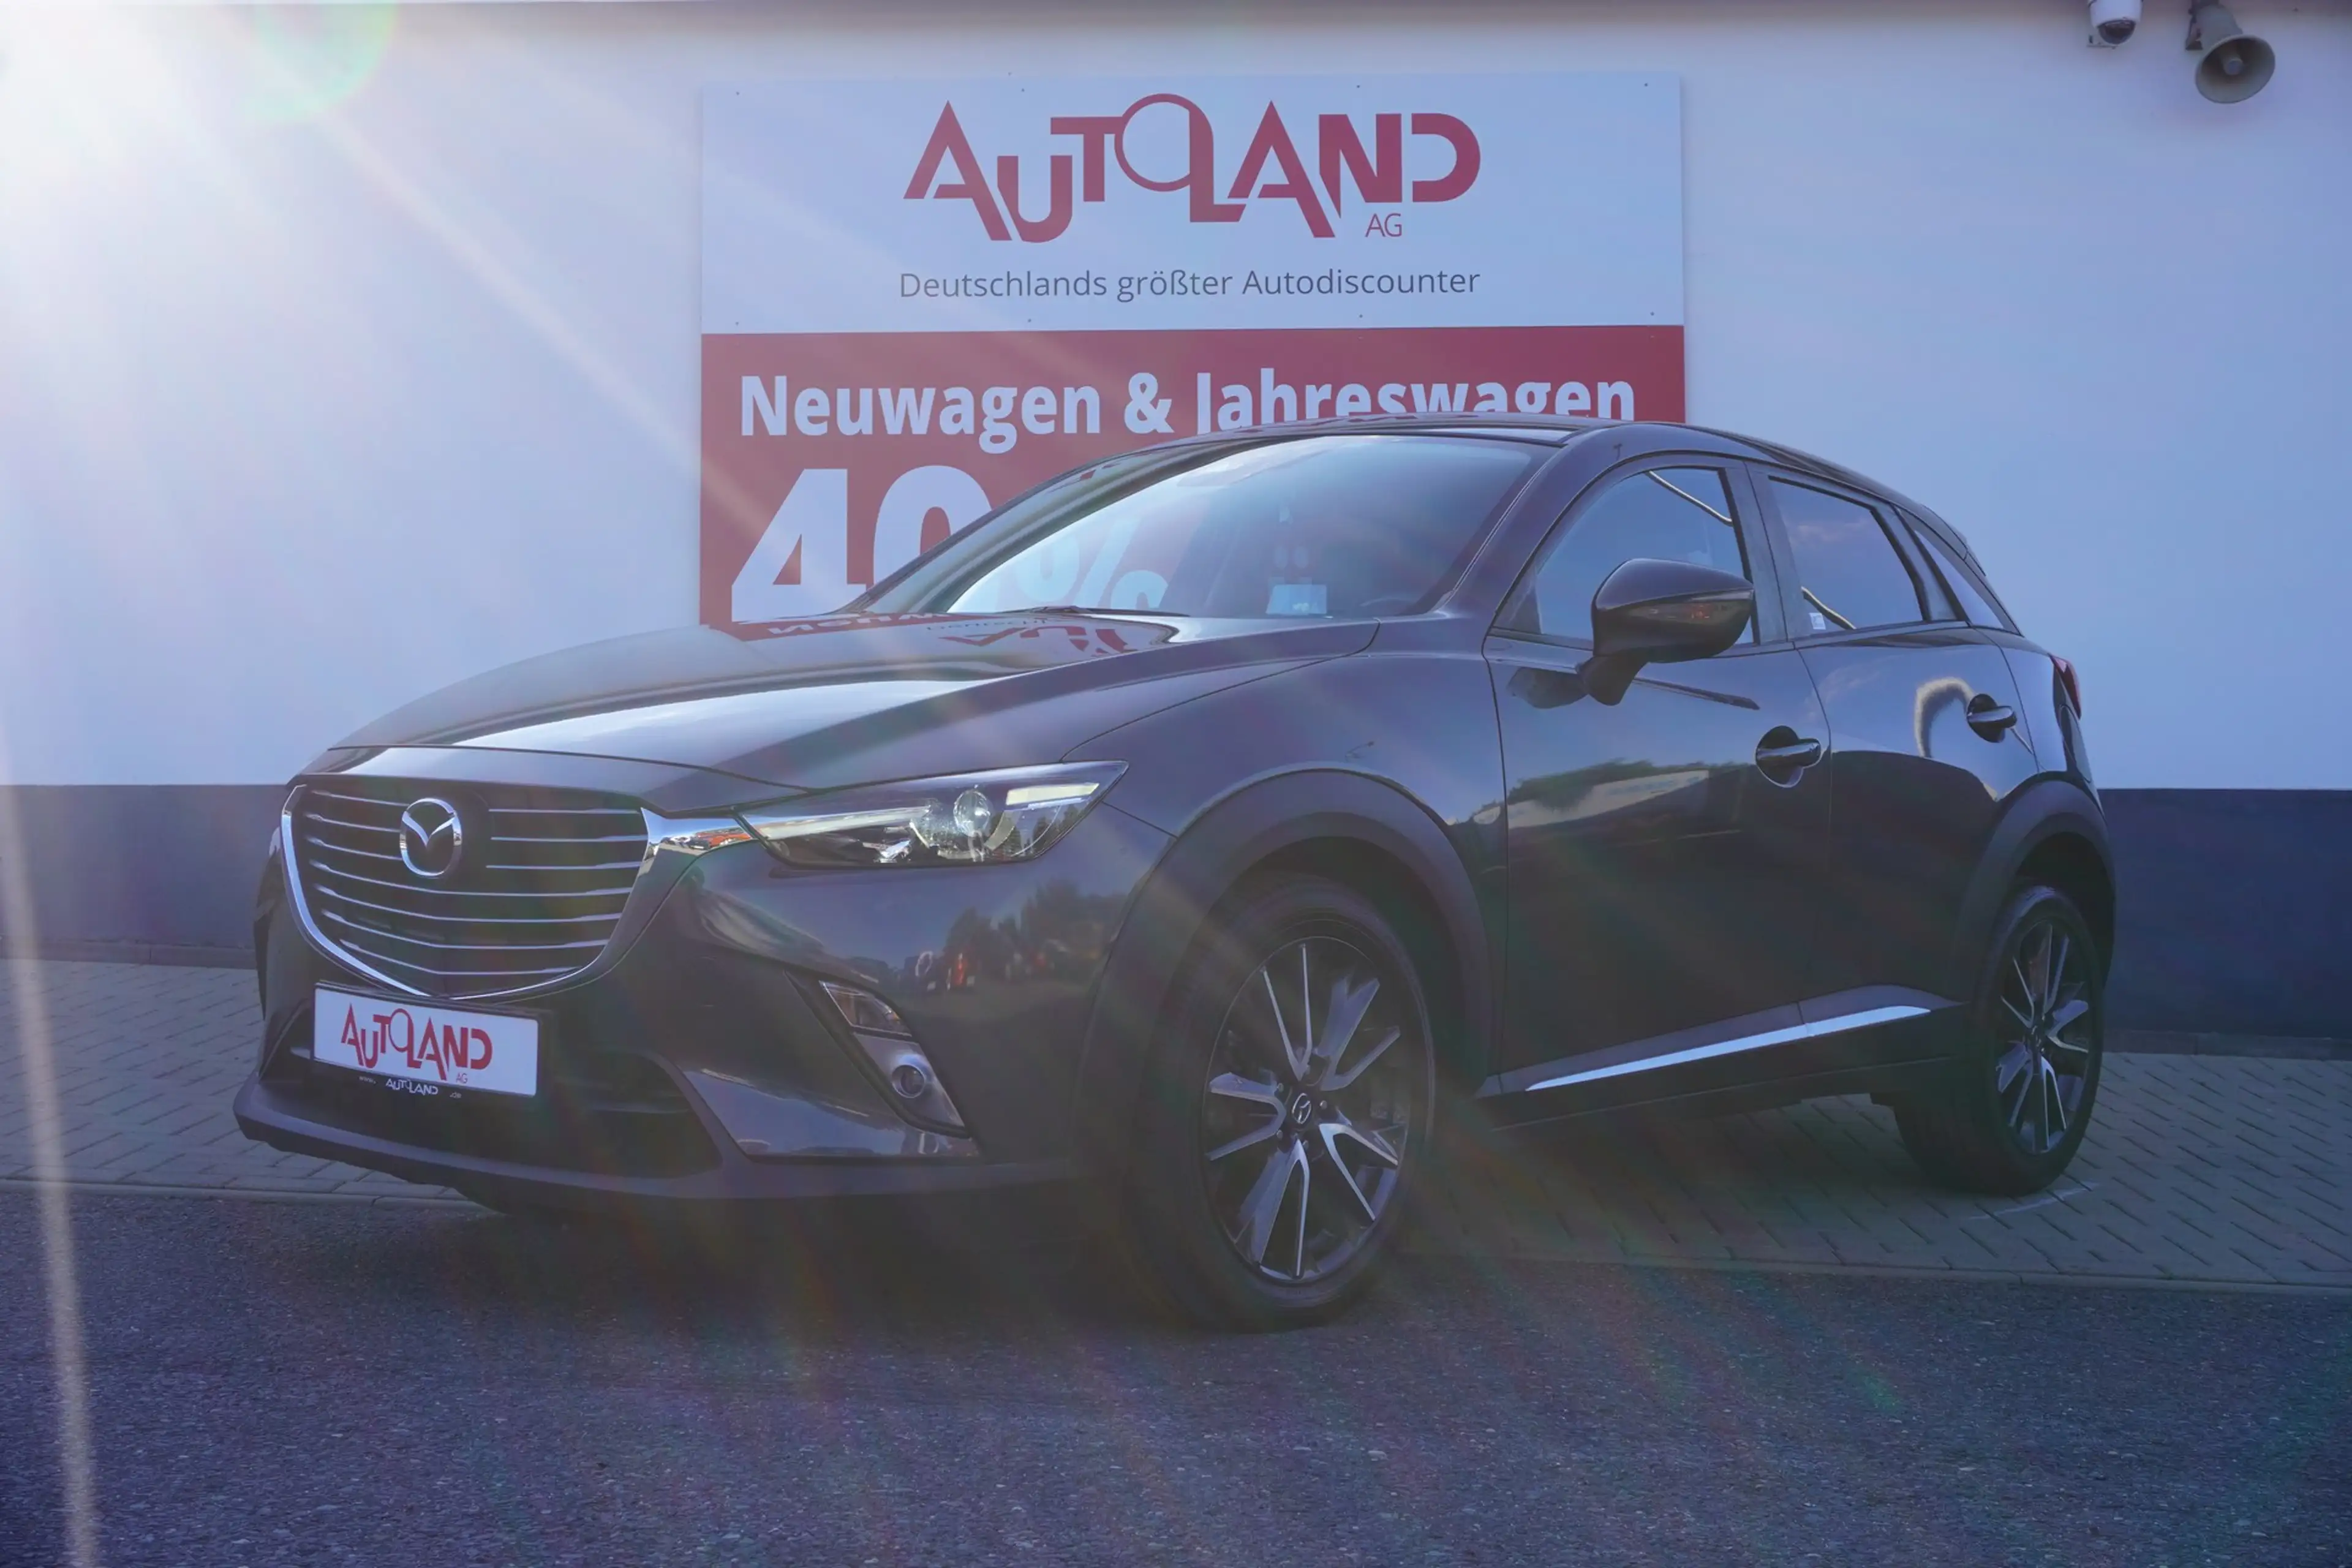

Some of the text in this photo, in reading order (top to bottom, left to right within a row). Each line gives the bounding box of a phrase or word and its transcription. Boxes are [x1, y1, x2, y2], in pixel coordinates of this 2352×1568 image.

[903, 93, 1481, 243] AUTOLAND
[1365, 213, 1403, 238] AG
[900, 268, 1481, 303] Deutschlands größter Autodiscounter
[741, 375, 1101, 454] Neuwagen
[1124, 372, 1175, 435] &
[341, 1003, 493, 1081] AUTOLAND
[385, 1078, 439, 1096] AUTOLAND
[455, 1072, 469, 1085] AG
